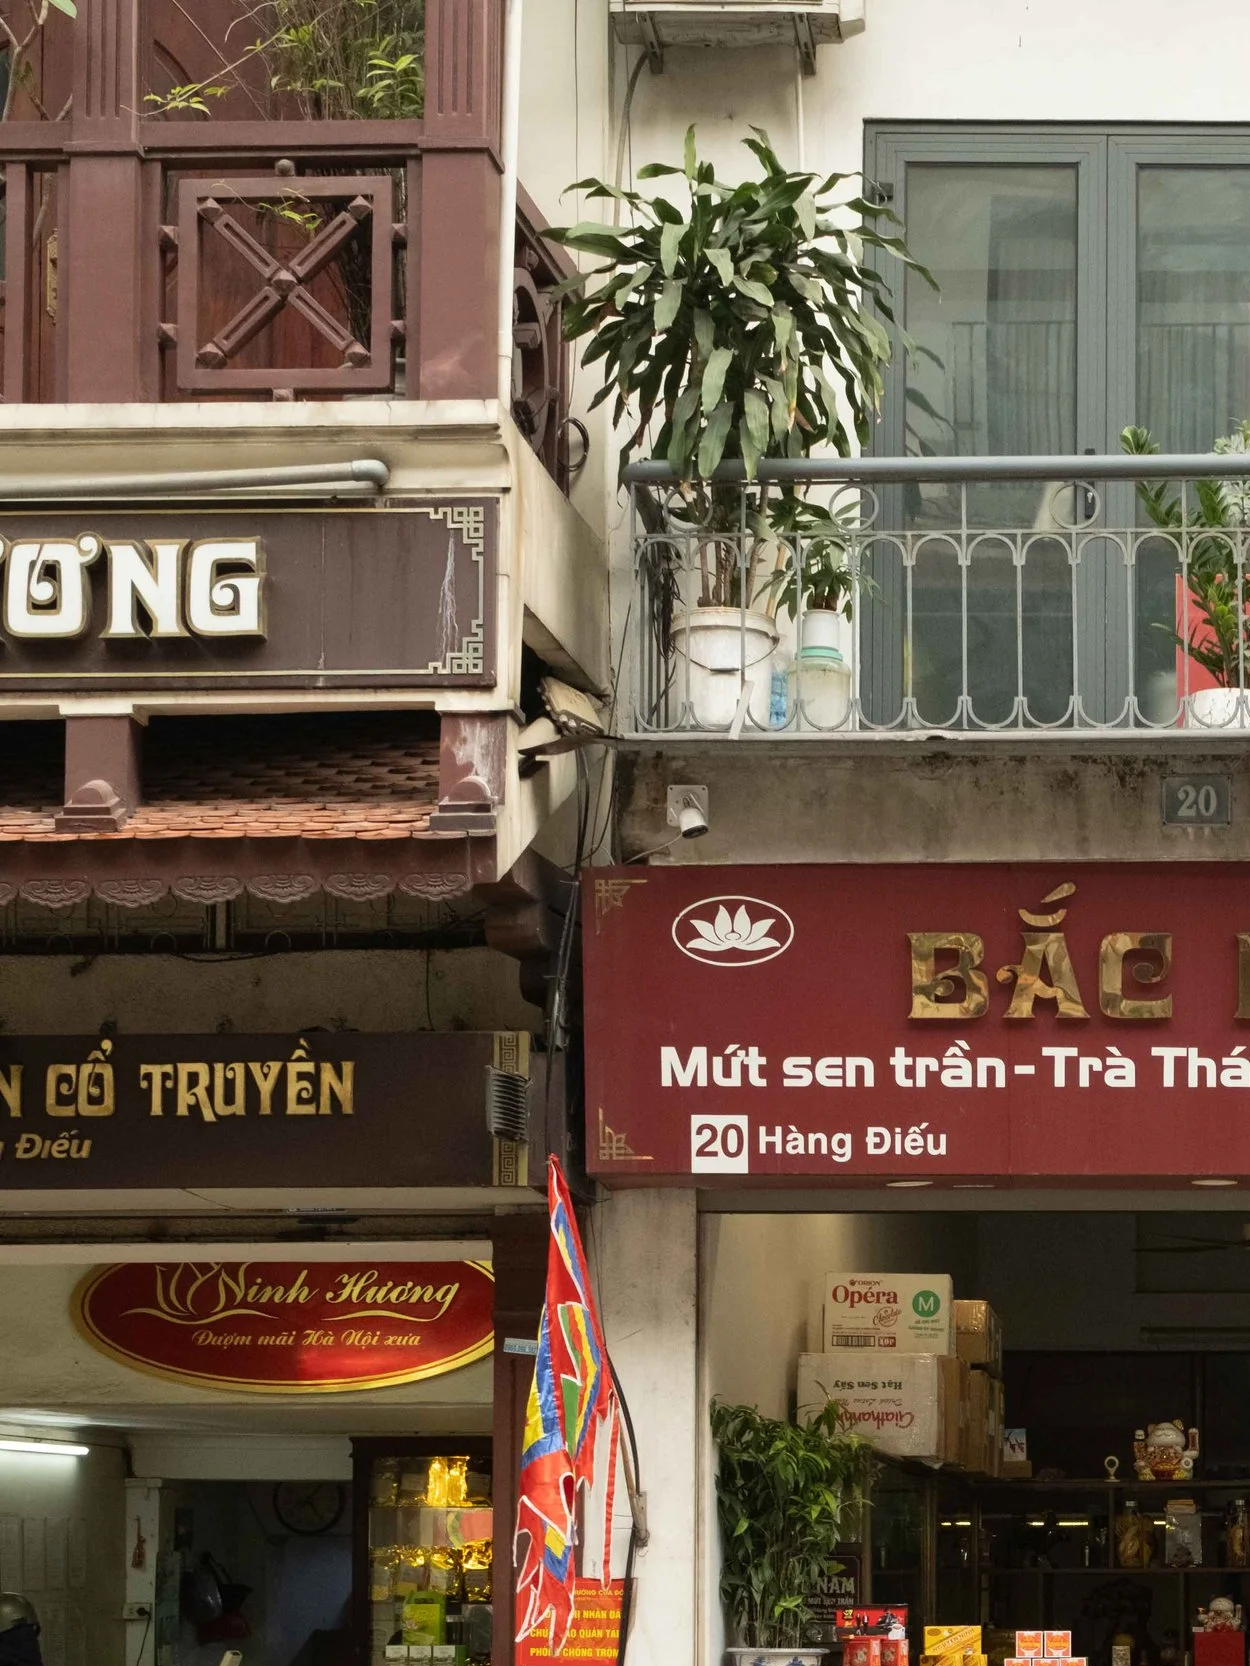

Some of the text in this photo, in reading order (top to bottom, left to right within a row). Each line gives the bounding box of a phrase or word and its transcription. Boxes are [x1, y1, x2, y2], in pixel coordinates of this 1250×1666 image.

[0, 535, 263, 637] ƠNG
[1177, 784, 1218, 817] 20
[907, 882, 1173, 1019] BẮC
[46, 1039, 115, 1117] CỔ
[140, 1038, 356, 1122] TRUYỀN
[660, 1043, 768, 1087] Mứt
[782, 1056, 875, 1088] sen
[15, 1130, 92, 1160] Điếu
[694, 1122, 947, 1163] 20 Hàng Điếu
[211, 1263, 460, 1322] Ninh Hương
[832, 1285, 899, 1308] Opéra
[918, 1297, 934, 1312] M
[302, 1329, 335, 1347] Hà
[342, 1328, 381, 1347] Nội
[386, 1333, 422, 1347] xưa
[857, 1381, 878, 1390] Sen
[882, 1380, 903, 1391] Hạt
